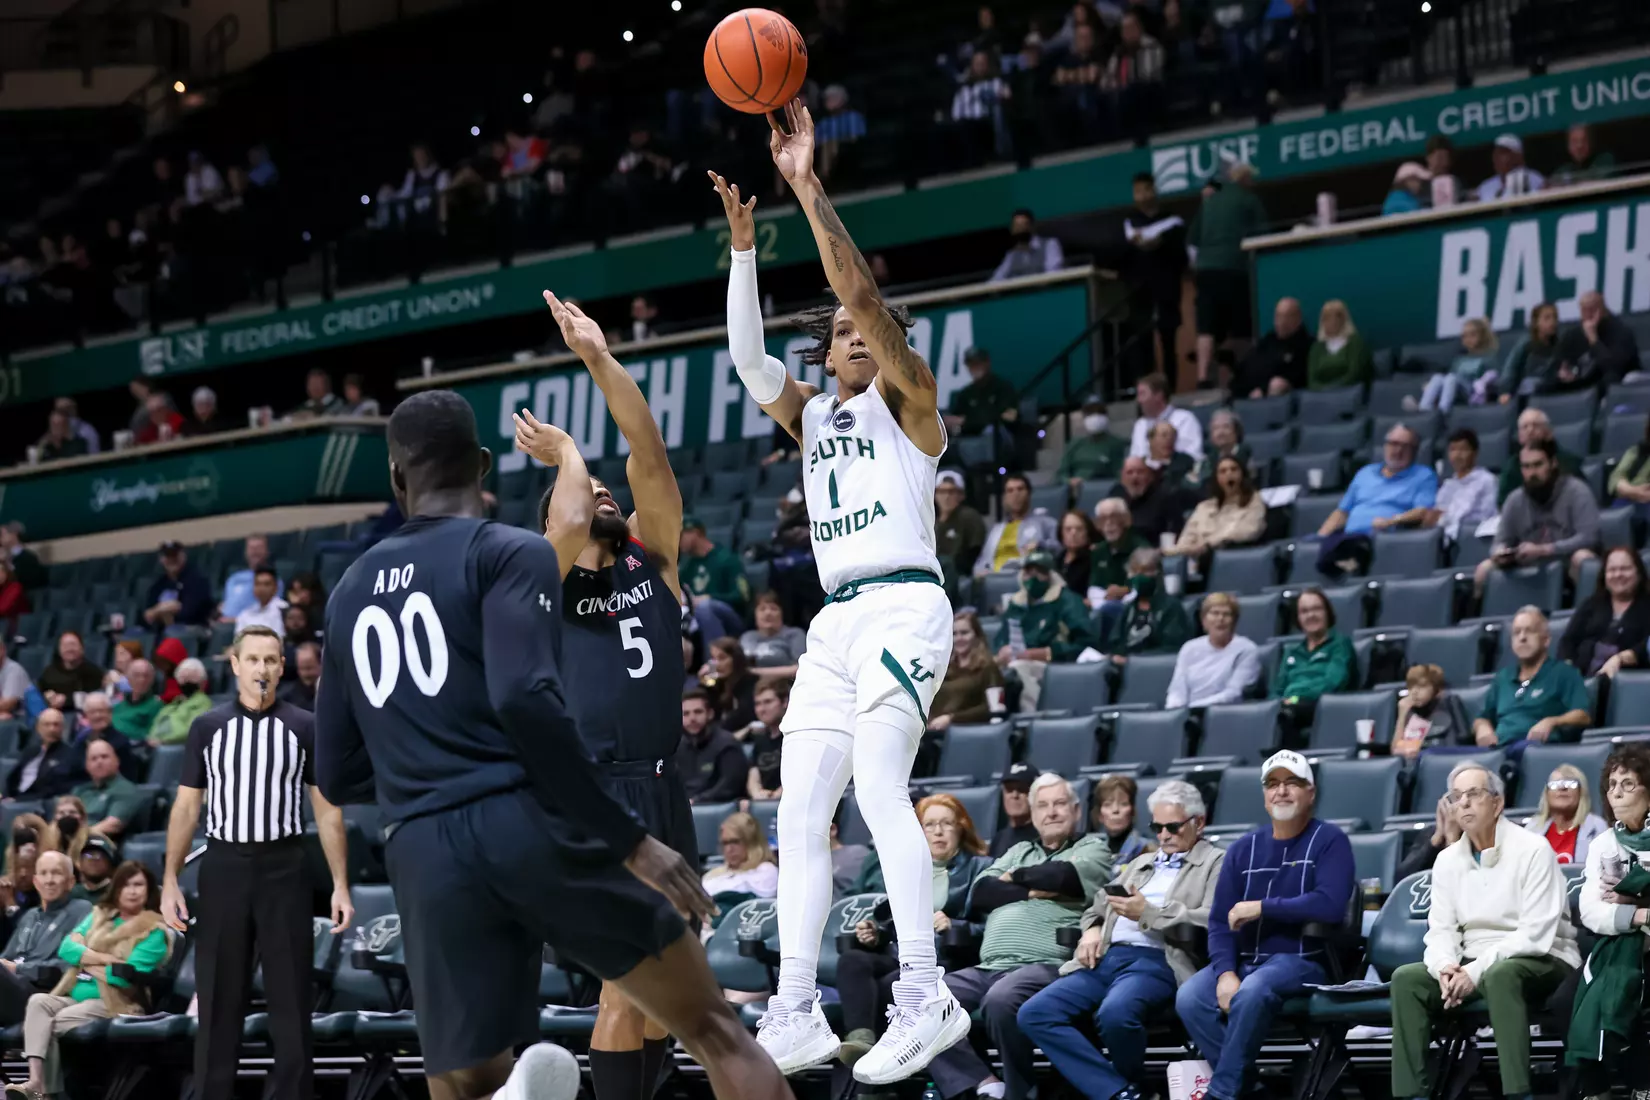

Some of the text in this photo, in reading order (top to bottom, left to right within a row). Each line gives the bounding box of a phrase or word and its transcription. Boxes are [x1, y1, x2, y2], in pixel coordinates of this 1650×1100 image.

[1190, 134, 1259, 178] USF
[1280, 116, 1425, 163] FEDERAL
[1437, 87, 1560, 135] CREDIT
[715, 222, 779, 270] 22
[220, 319, 316, 354] FEDERAL
[322, 299, 402, 336] CREDIT
[811, 435, 875, 472] UTH
[828, 468, 841, 510] 1
[812, 500, 888, 542] LORIDA
[373, 563, 414, 595] ADO
[352, 591, 449, 708] 00
[618, 616, 653, 678] 5
